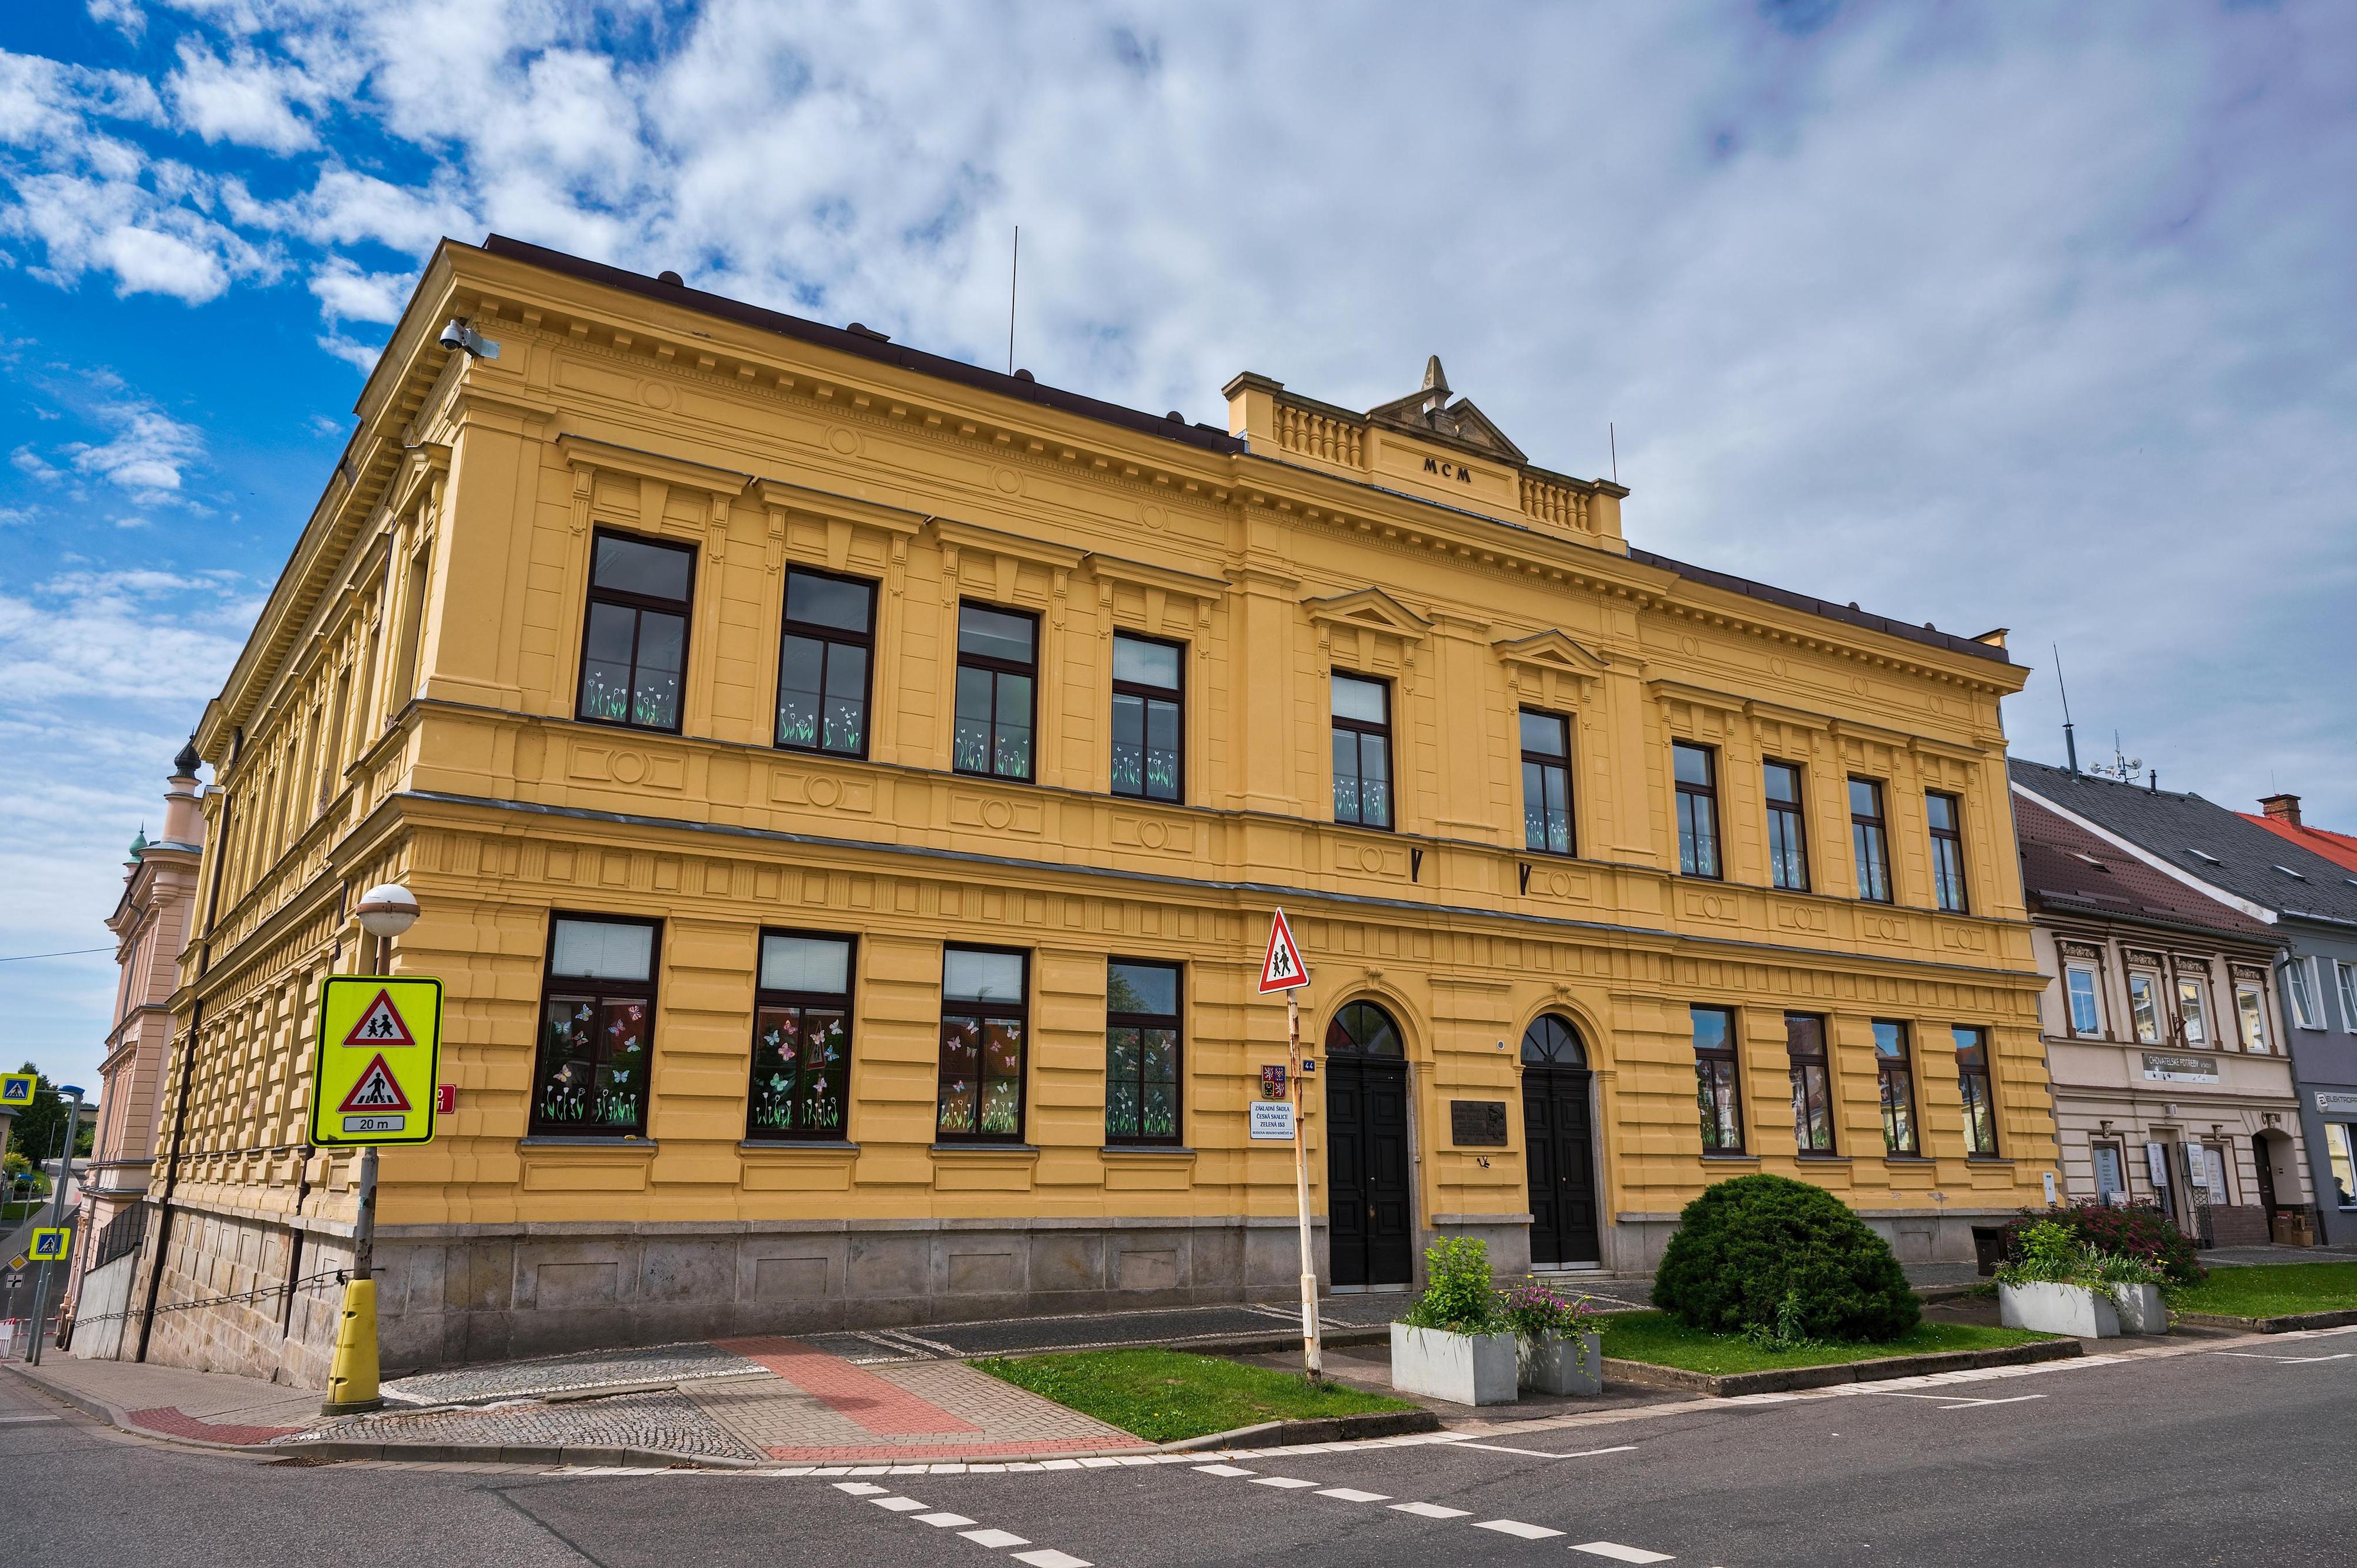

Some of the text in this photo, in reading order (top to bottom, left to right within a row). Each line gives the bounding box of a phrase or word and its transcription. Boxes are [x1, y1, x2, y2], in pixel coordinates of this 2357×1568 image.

[1424, 458, 1471, 483] MCM
[2149, 1056, 2180, 1066] CHOVATELSKÉ
[2180, 1057, 2199, 1068] POTŘEBY
[359, 1119, 374, 1130] 20
